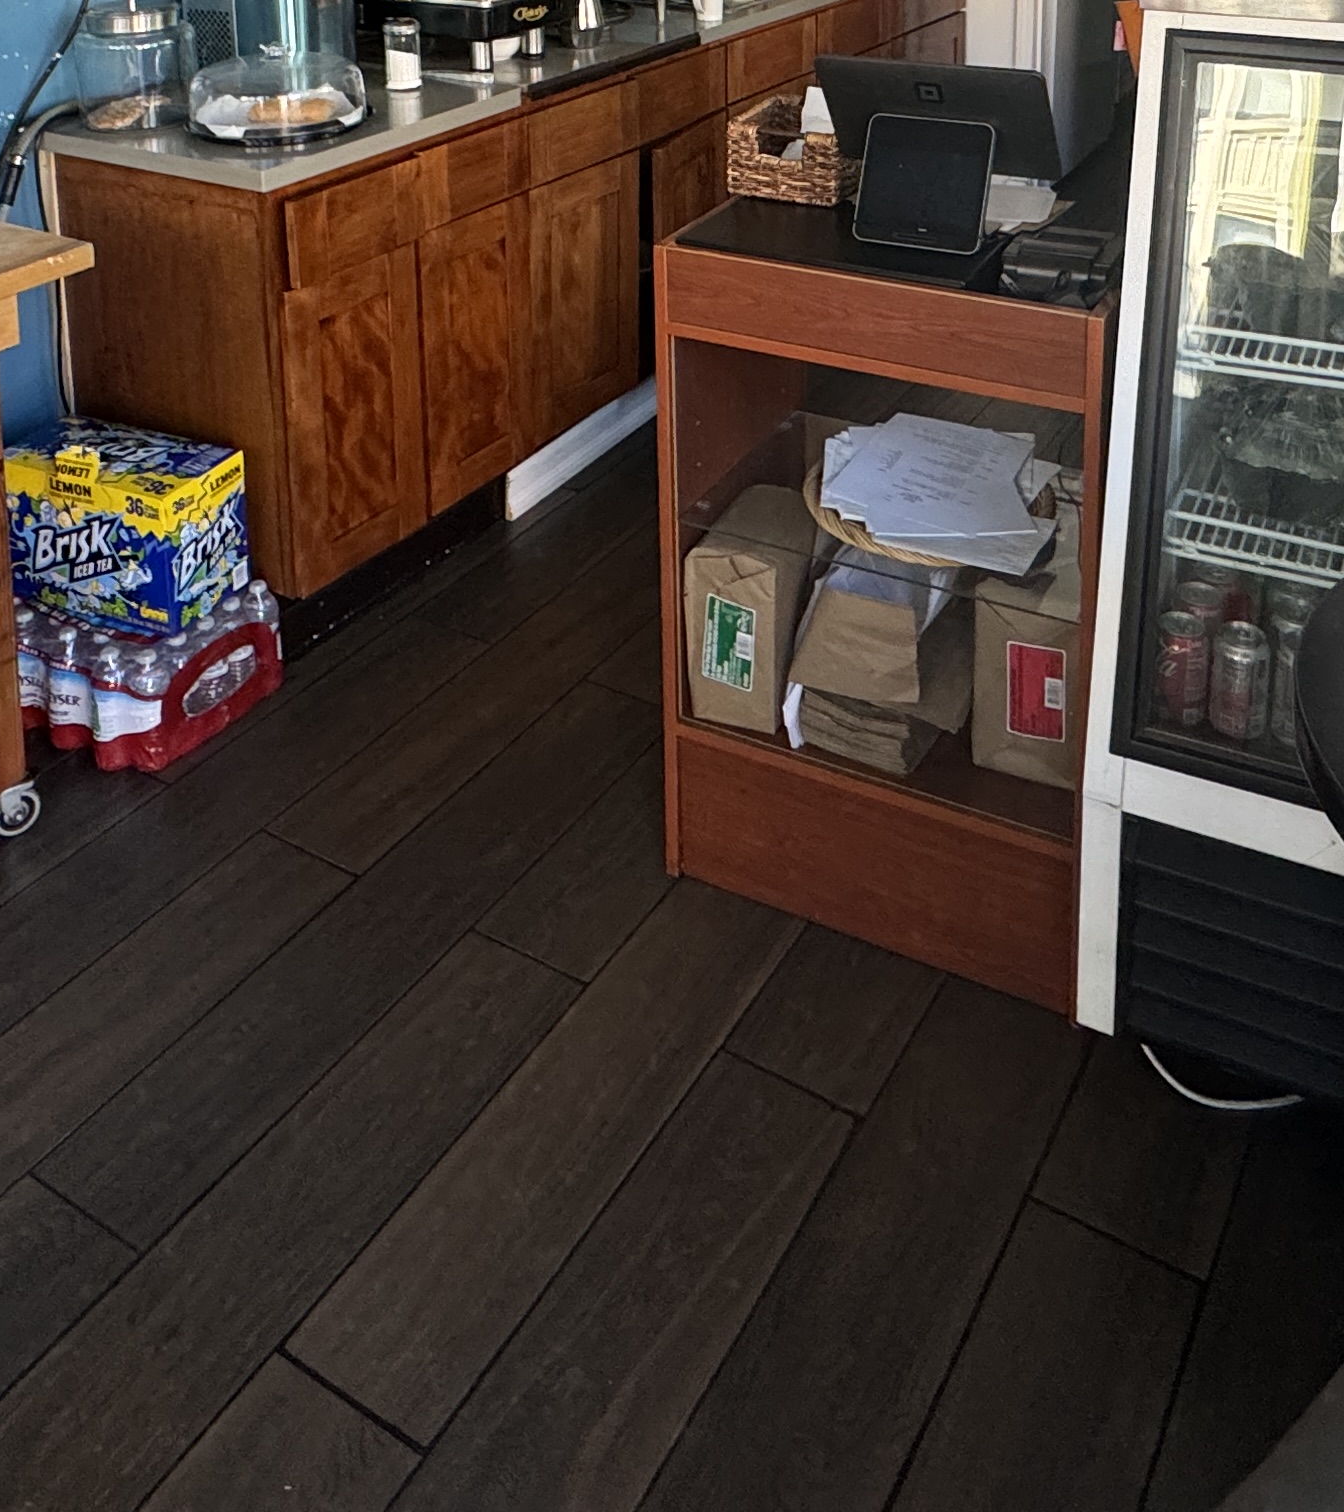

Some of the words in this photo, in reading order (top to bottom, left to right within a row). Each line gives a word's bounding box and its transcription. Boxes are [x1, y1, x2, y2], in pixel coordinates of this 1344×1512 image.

[49, 477, 92, 498] LEMON
[209, 465, 242, 493] LEMON
[125, 496, 143, 517] 36
[34, 520, 112, 570] Brisk
[73, 563, 95, 579] ICED
[97, 558, 114, 573] TEA
